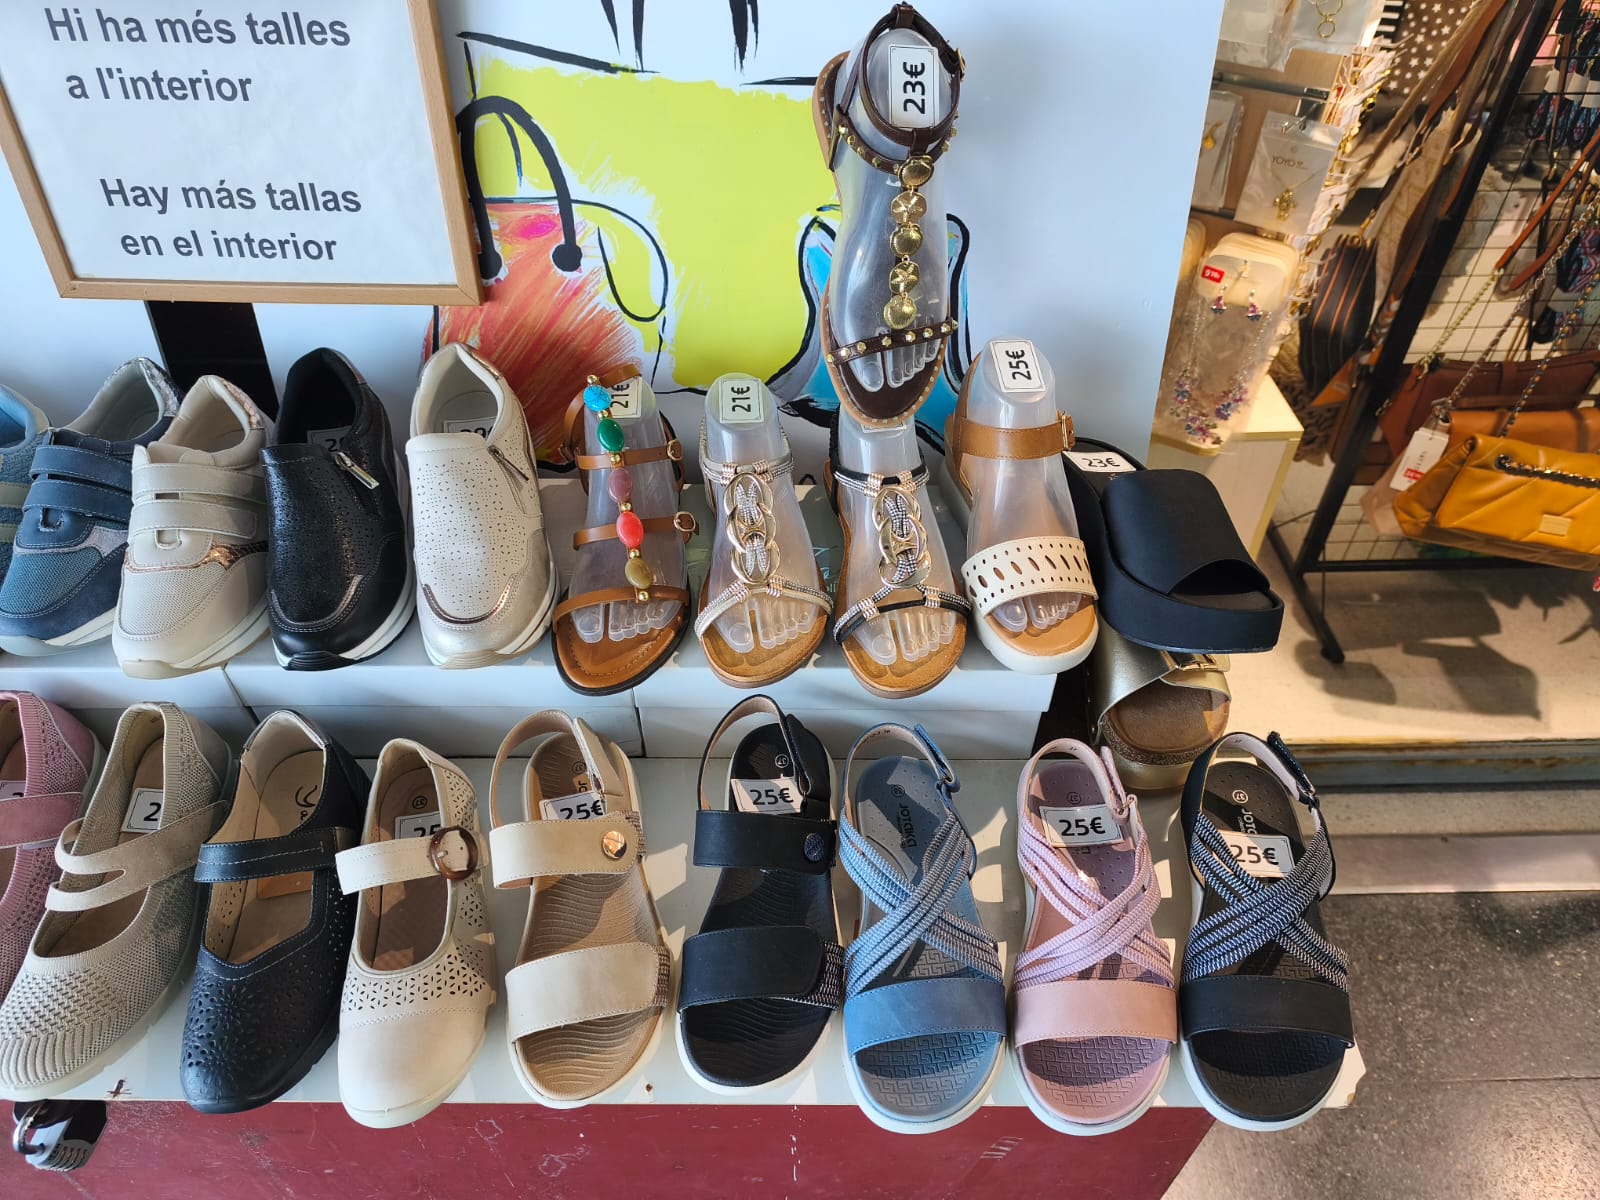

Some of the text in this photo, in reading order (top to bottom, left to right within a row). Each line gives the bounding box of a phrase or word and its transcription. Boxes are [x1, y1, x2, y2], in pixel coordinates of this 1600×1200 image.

[44, 7, 350, 46] Hi ha més talles
[65, 67, 251, 102] a l'interior
[902, 61, 926, 115] 23€
[99, 178, 362, 215] Hay más tallas
[120, 230, 337, 260] en el interior
[1005, 349, 1032, 381] 25€
[730, 385, 752, 413] 21€
[1080, 457, 1121, 468] 23€
[559, 799, 604, 820] 25€
[749, 787, 794, 806] 25€
[1058, 816, 1106, 837] 25€
[1230, 844, 1279, 866] 25€
